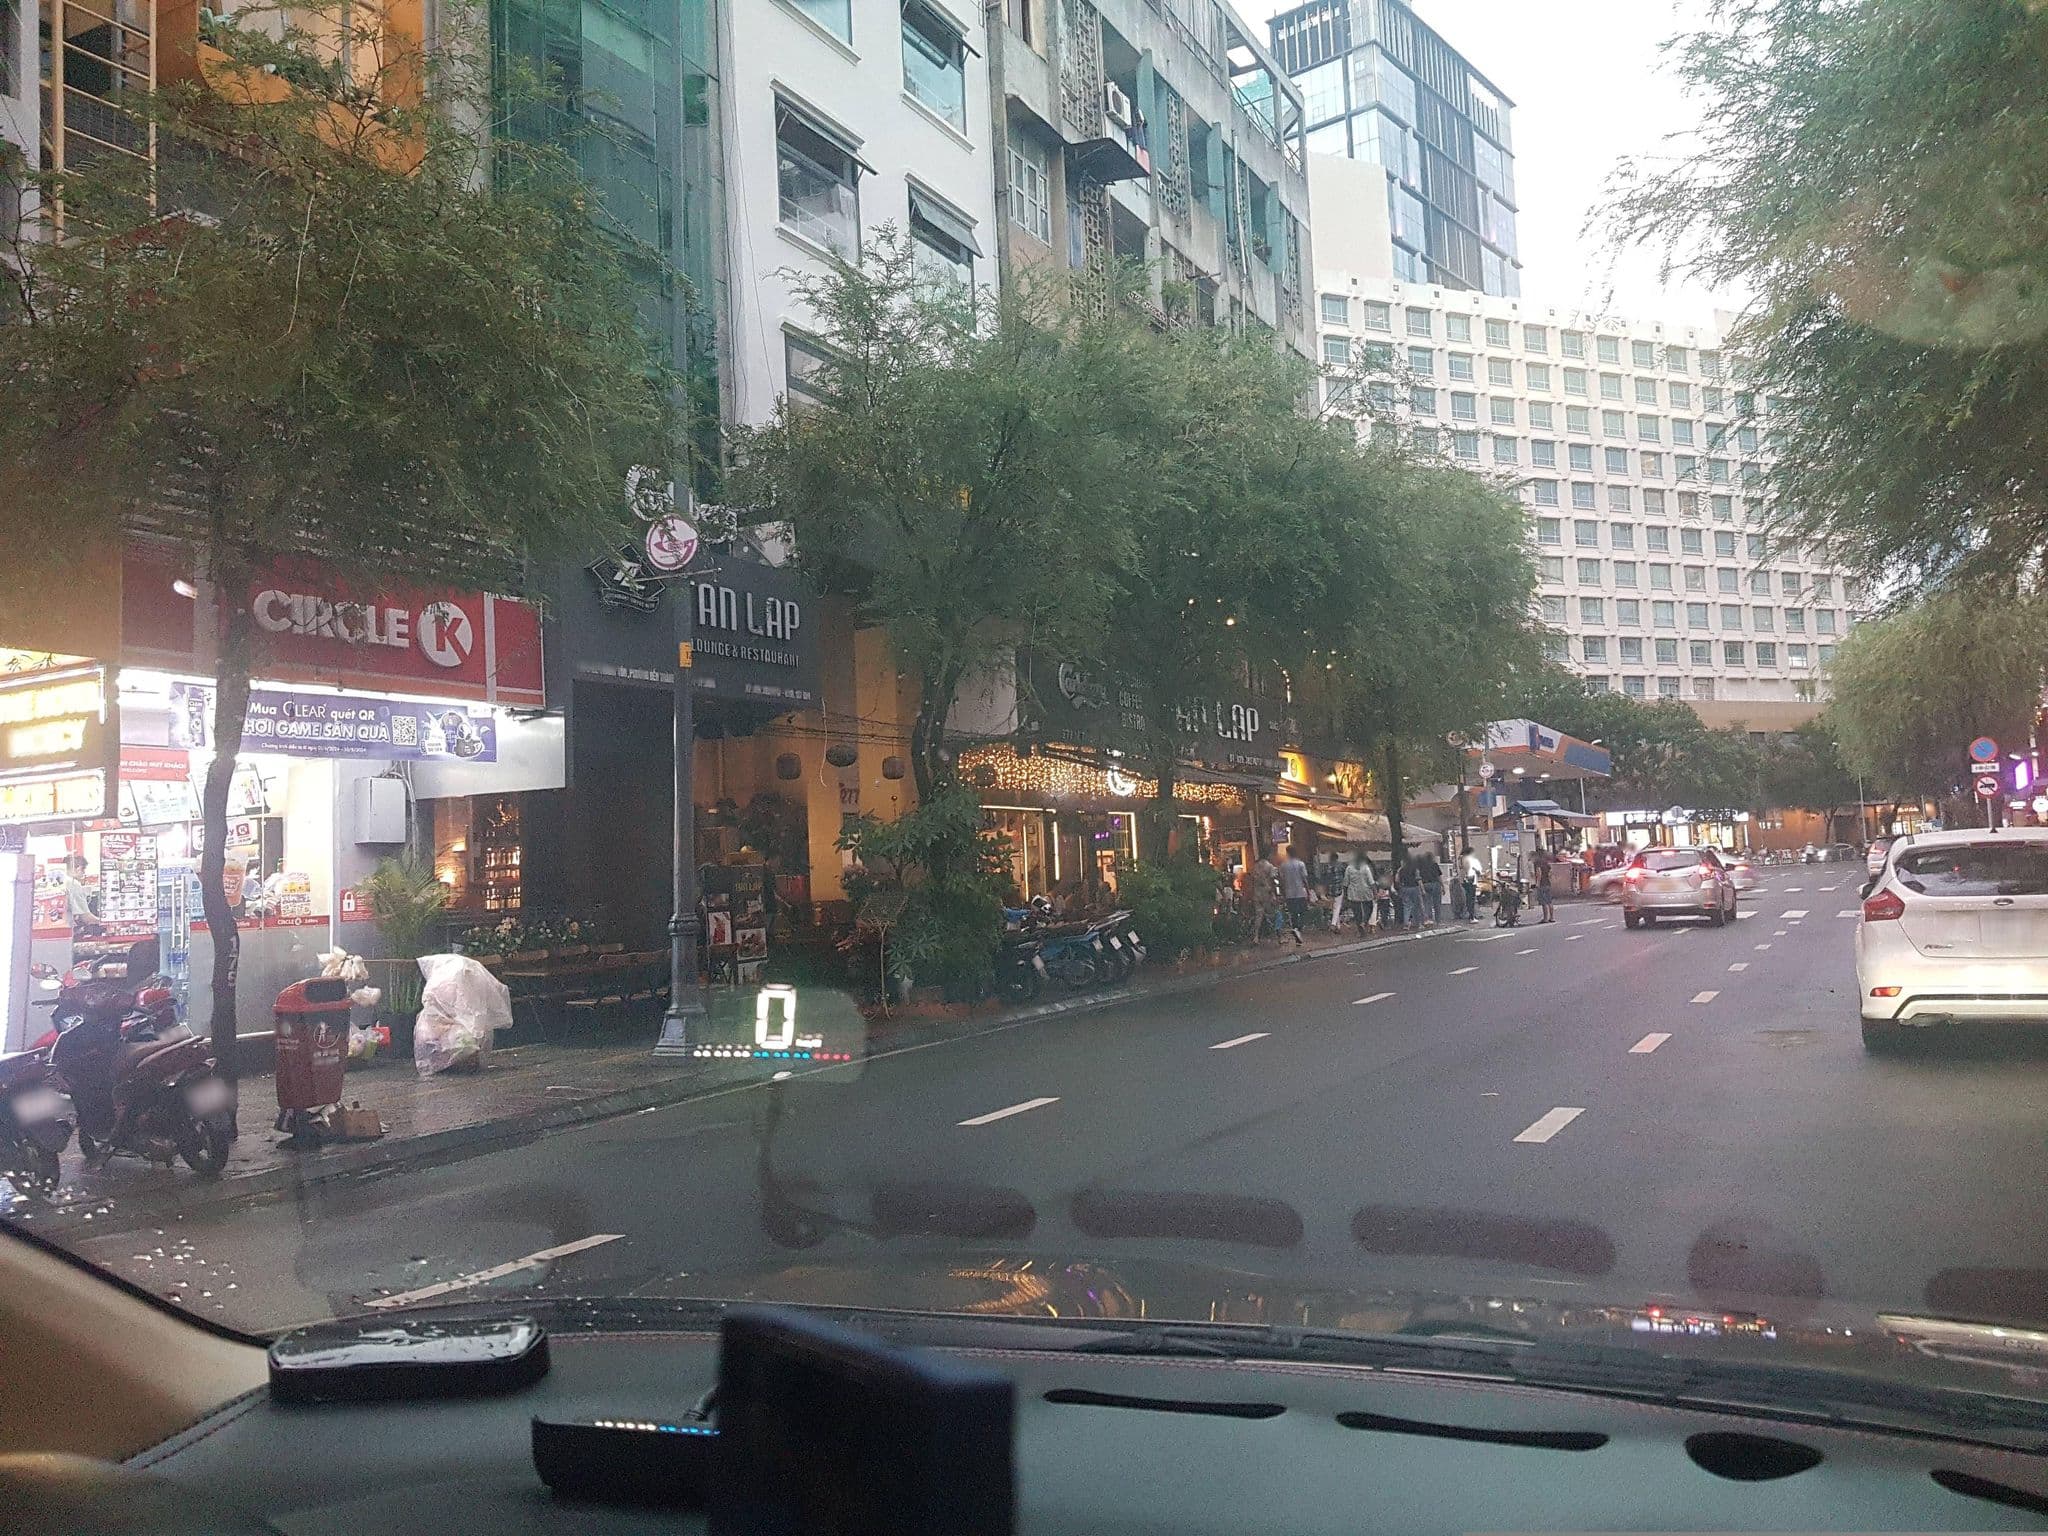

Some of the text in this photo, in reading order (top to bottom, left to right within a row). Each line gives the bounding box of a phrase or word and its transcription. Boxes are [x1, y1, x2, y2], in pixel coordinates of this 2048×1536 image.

[698, 583, 737, 631] AN
[746, 592, 800, 640] LAP
[253, 589, 471, 665] CIRCLE K
[690, 638, 732, 657] LOUNGE
[249, 701, 375, 721] Mua CLEAR quét QR
[1216, 701, 1259, 741] LAP
[241, 719, 274, 736] HƠI
[276, 721, 321, 738] GAME
